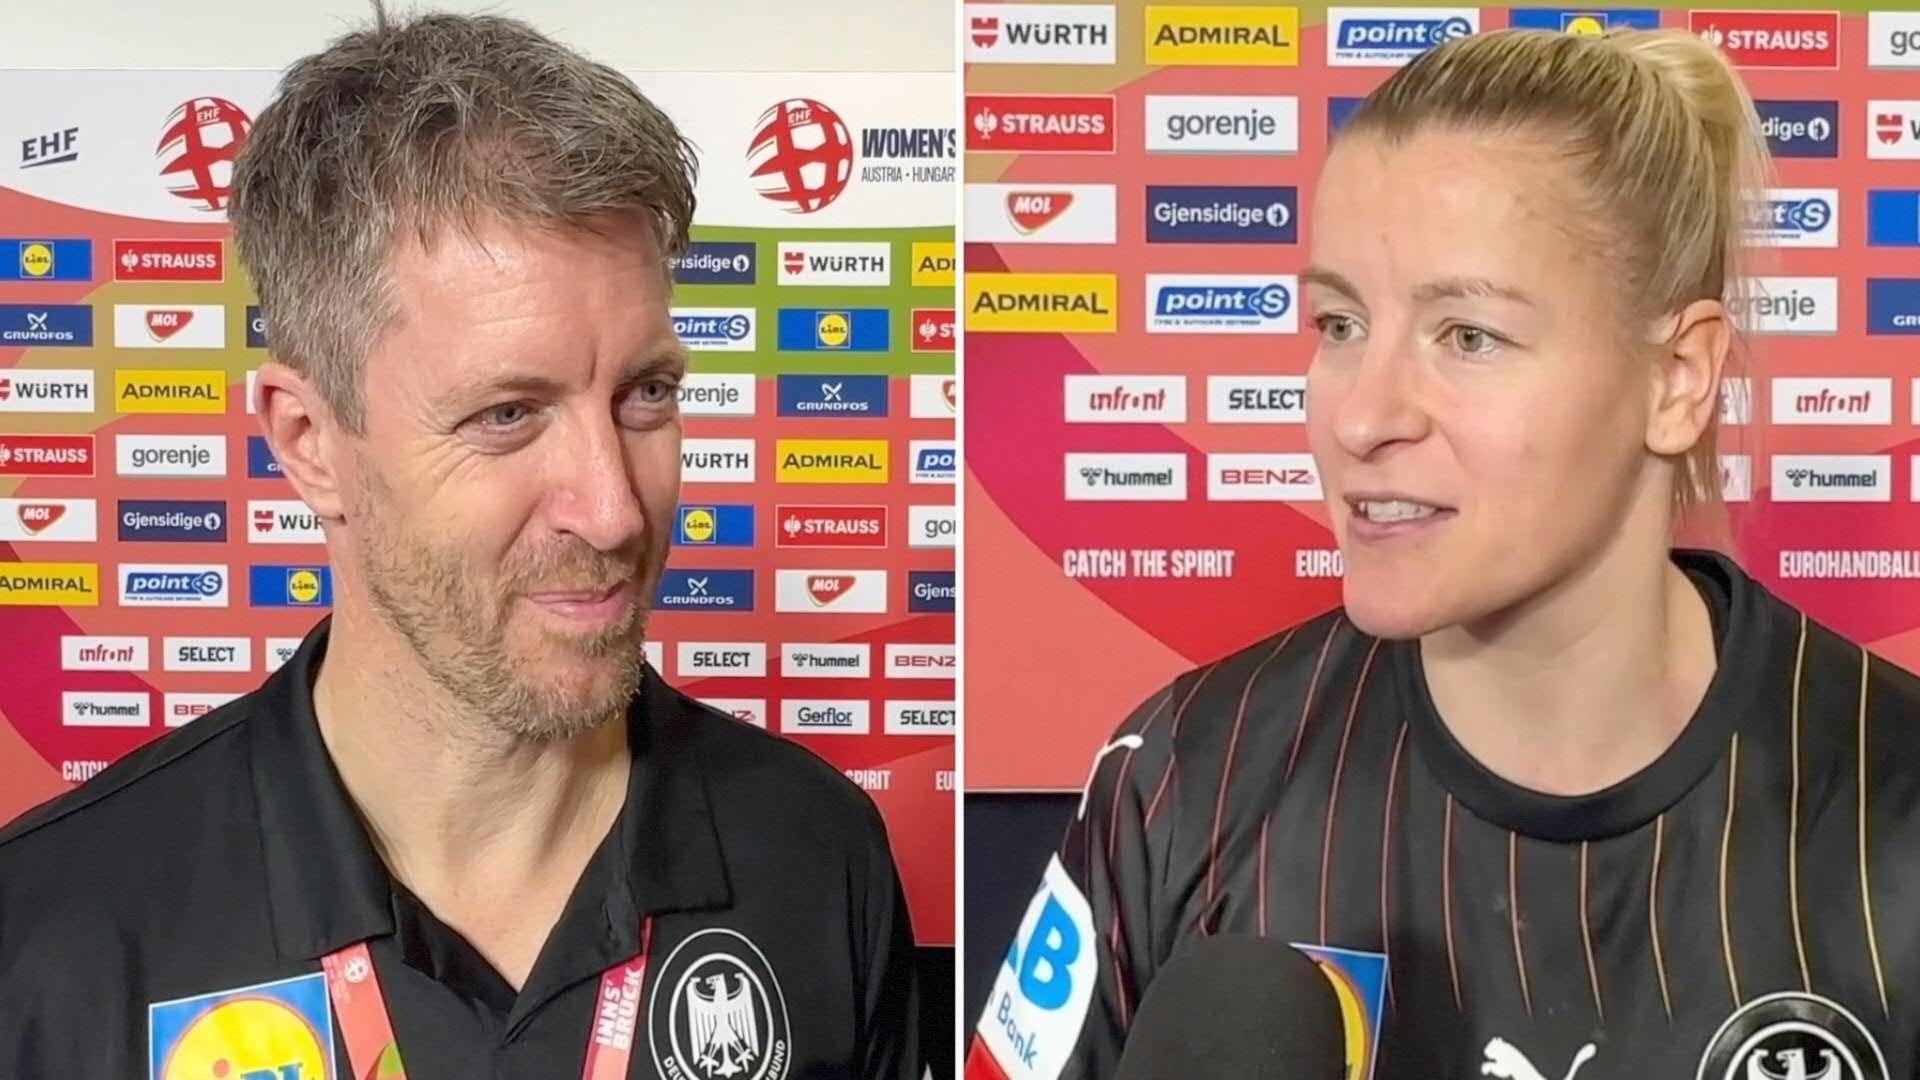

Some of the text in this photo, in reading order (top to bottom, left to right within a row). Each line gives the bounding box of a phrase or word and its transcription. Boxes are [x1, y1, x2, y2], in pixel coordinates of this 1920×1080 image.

[1154, 24, 1290, 47] ADMIRAL
[1347, 23, 1427, 46] point
[1727, 30, 1829, 50] STRAUSS
[196, 107, 221, 122] EHF
[787, 109, 812, 125] EHF
[1002, 114, 1105, 134] STRAUSS
[1168, 109, 1276, 140] gorenje
[22, 127, 79, 162] EHF
[862, 128, 956, 159] WOMEN'S
[861, 166, 956, 182] AUSTRIA HUNGAR
[1014, 197, 1052, 214] MOL
[1154, 203, 1264, 227] Gjensidige
[141, 254, 216, 269] STRAUSS
[973, 291, 1109, 314] ADMIRAL
[1165, 290, 1246, 313] point
[151, 314, 178, 327] MOL
[674, 318, 717, 334] oint
[3, 331, 74, 341] GRUNDFOS
[121, 383, 220, 400] ADMIRAL
[680, 382, 739, 406] orenje
[1229, 388, 1306, 411] SELECT
[797, 402, 869, 411] GRUNDFOS
[13, 448, 88, 462] STRAUSS
[132, 445, 210, 467] gorenje
[782, 453, 882, 470] ADMIRAL
[1104, 468, 1173, 486] hummel
[1220, 469, 1309, 485] BENZ
[1809, 470, 1877, 487] hummel
[23, 508, 50, 520] MOL
[123, 512, 202, 529] Gjensidige
[279, 514, 323, 530] WÜR
[804, 520, 880, 535] STRAUSS
[1063, 549, 1236, 578] CATCH THE SPIRIT
[0, 575, 92, 592] ADMIRAL
[132, 575, 190, 592] point
[812, 579, 839, 592] MOL
[663, 596, 734, 605] GRUNDFOS
[178, 646, 235, 662] SELECT
[693, 652, 750, 667] SELECT
[809, 654, 860, 667] hummel
[894, 656, 956, 667] BENZ
[90, 703, 140, 716] hummel
[797, 707, 852, 726] Gerflor
[612, 966, 644, 1051] BRUCK
[997, 991, 1037, 1070] Bank
